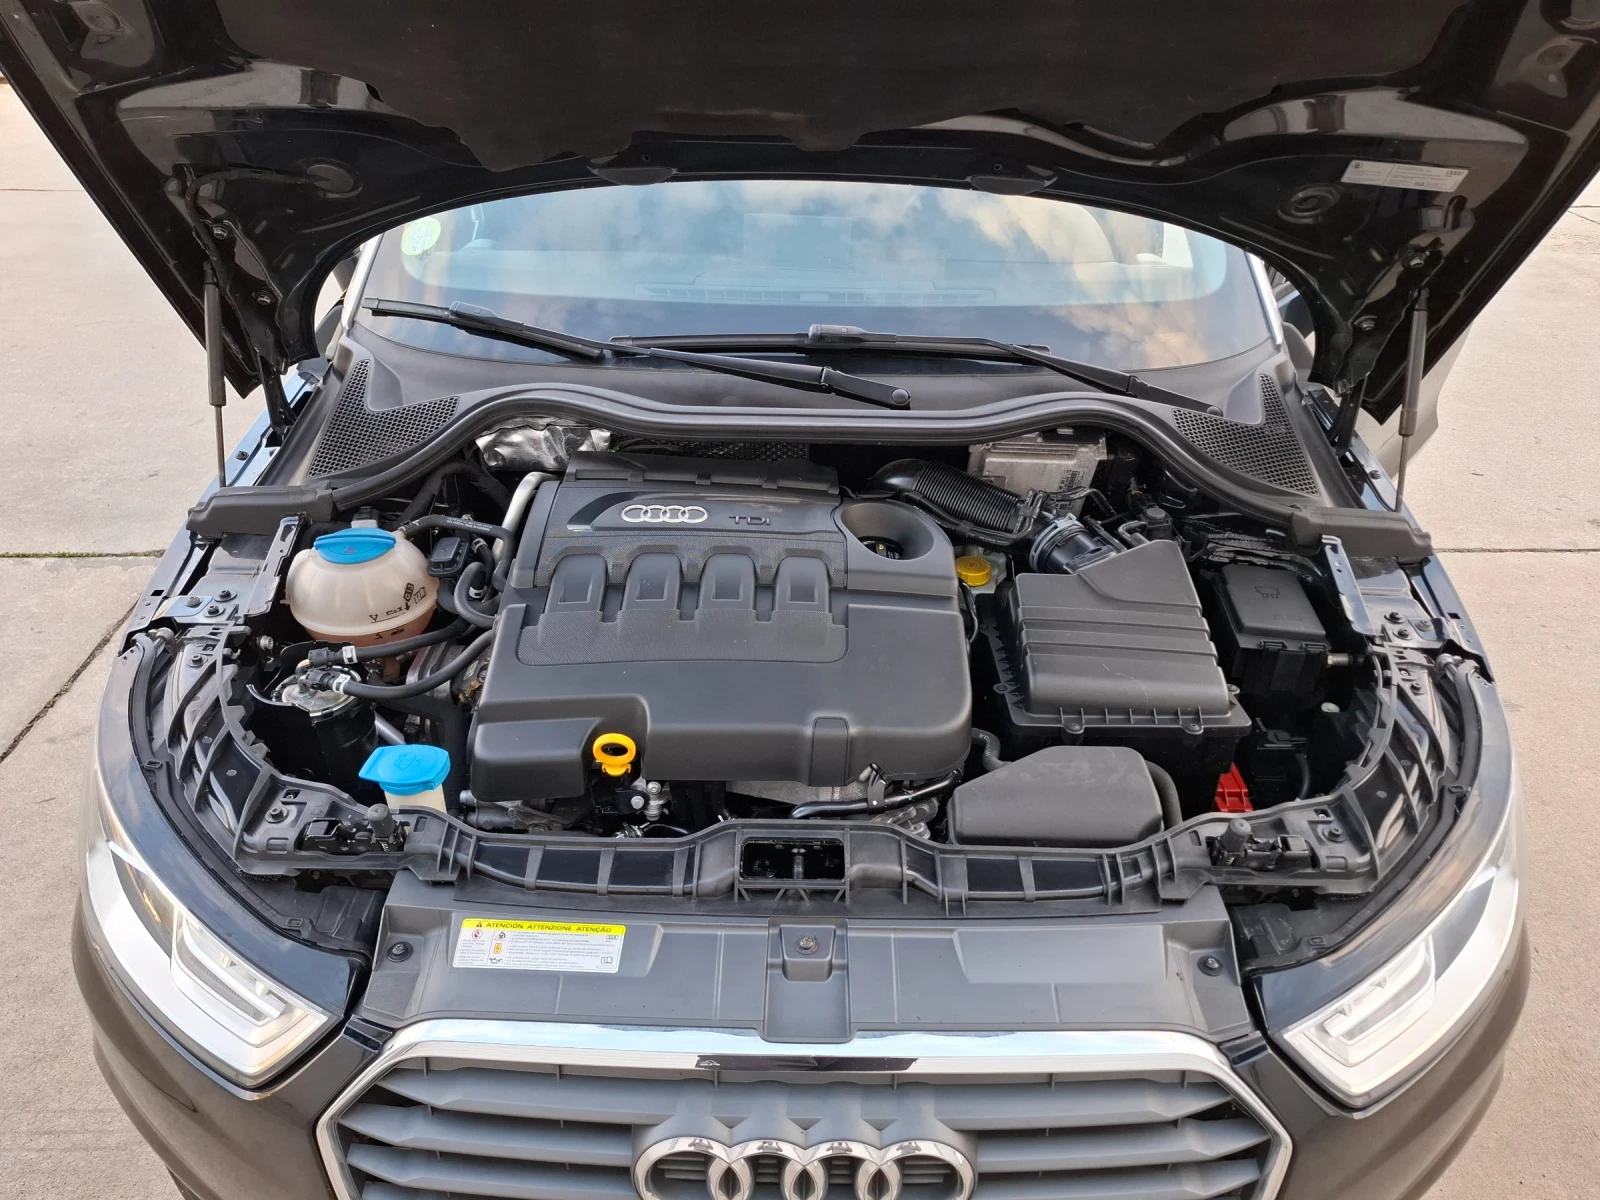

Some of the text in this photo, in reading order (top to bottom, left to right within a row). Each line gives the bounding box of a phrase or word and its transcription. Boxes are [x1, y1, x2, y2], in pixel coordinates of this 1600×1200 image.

[728, 515, 770, 526] TDI
[527, 923, 573, 932] ATTENZIONE
[576, 926, 612, 934] ATENÇÃO
